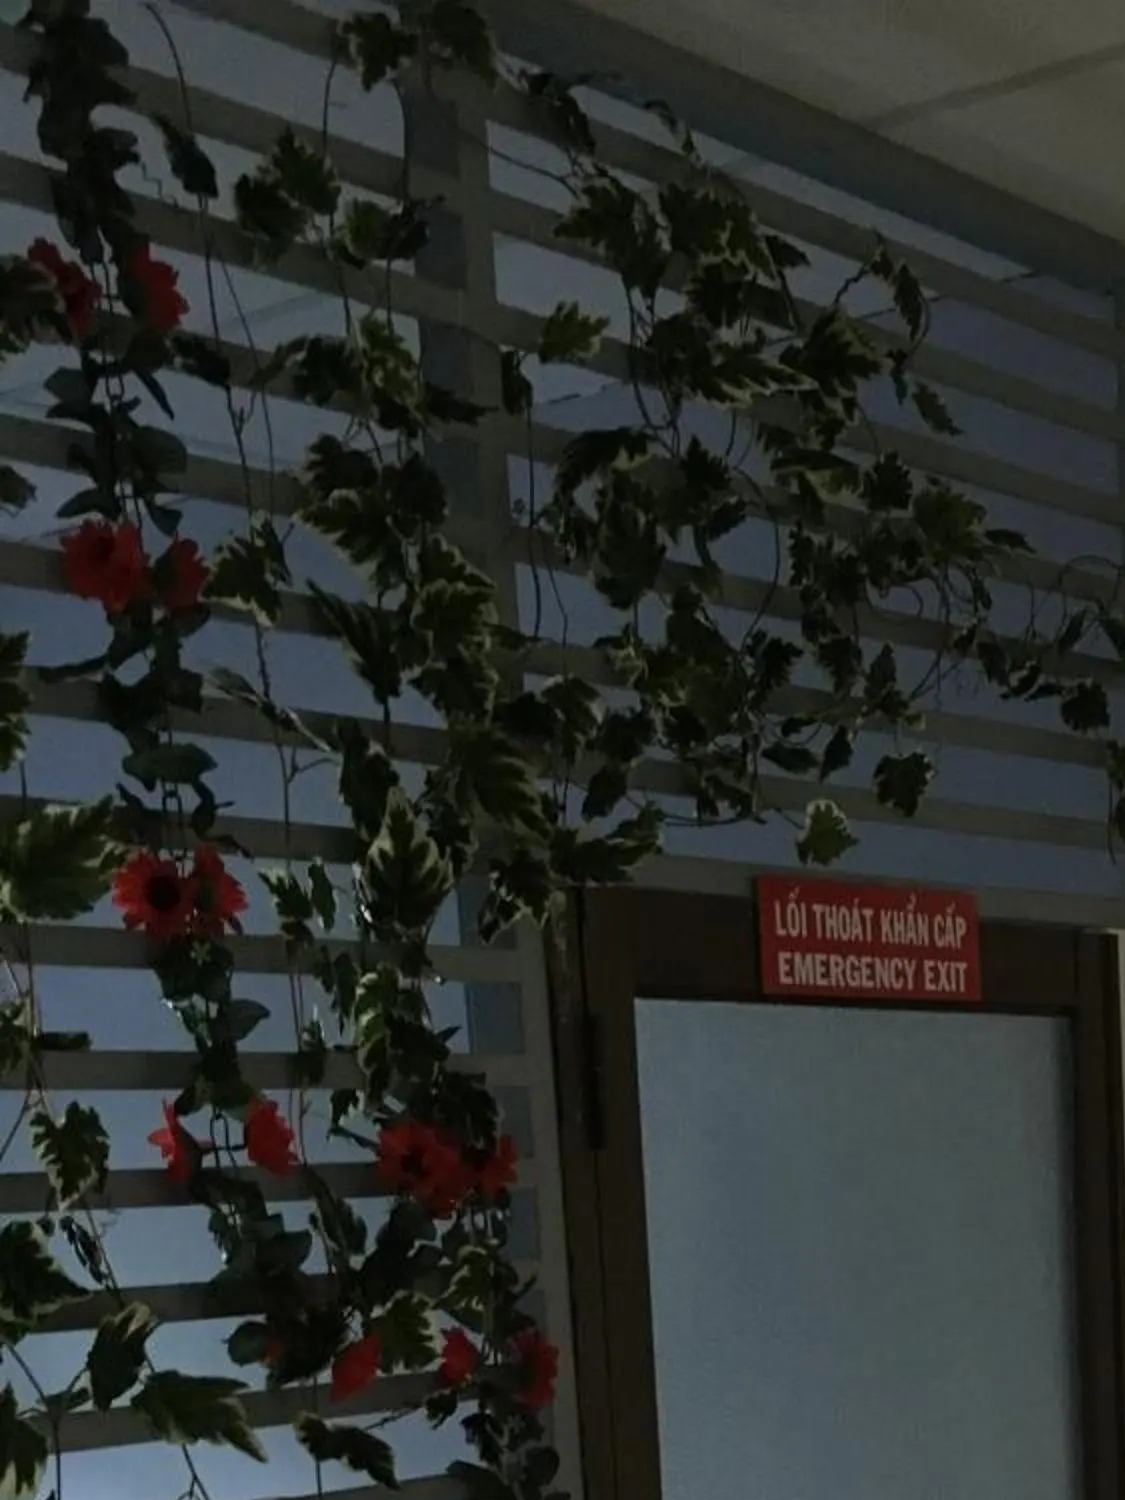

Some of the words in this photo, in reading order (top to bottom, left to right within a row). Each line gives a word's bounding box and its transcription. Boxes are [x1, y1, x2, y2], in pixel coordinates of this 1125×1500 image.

[774, 886, 807, 938] LỐI
[812, 899, 874, 943] THOÁT
[934, 903, 967, 949] CẤP
[778, 952, 916, 990] EMERGENCY
[924, 960, 968, 993] EXIT
